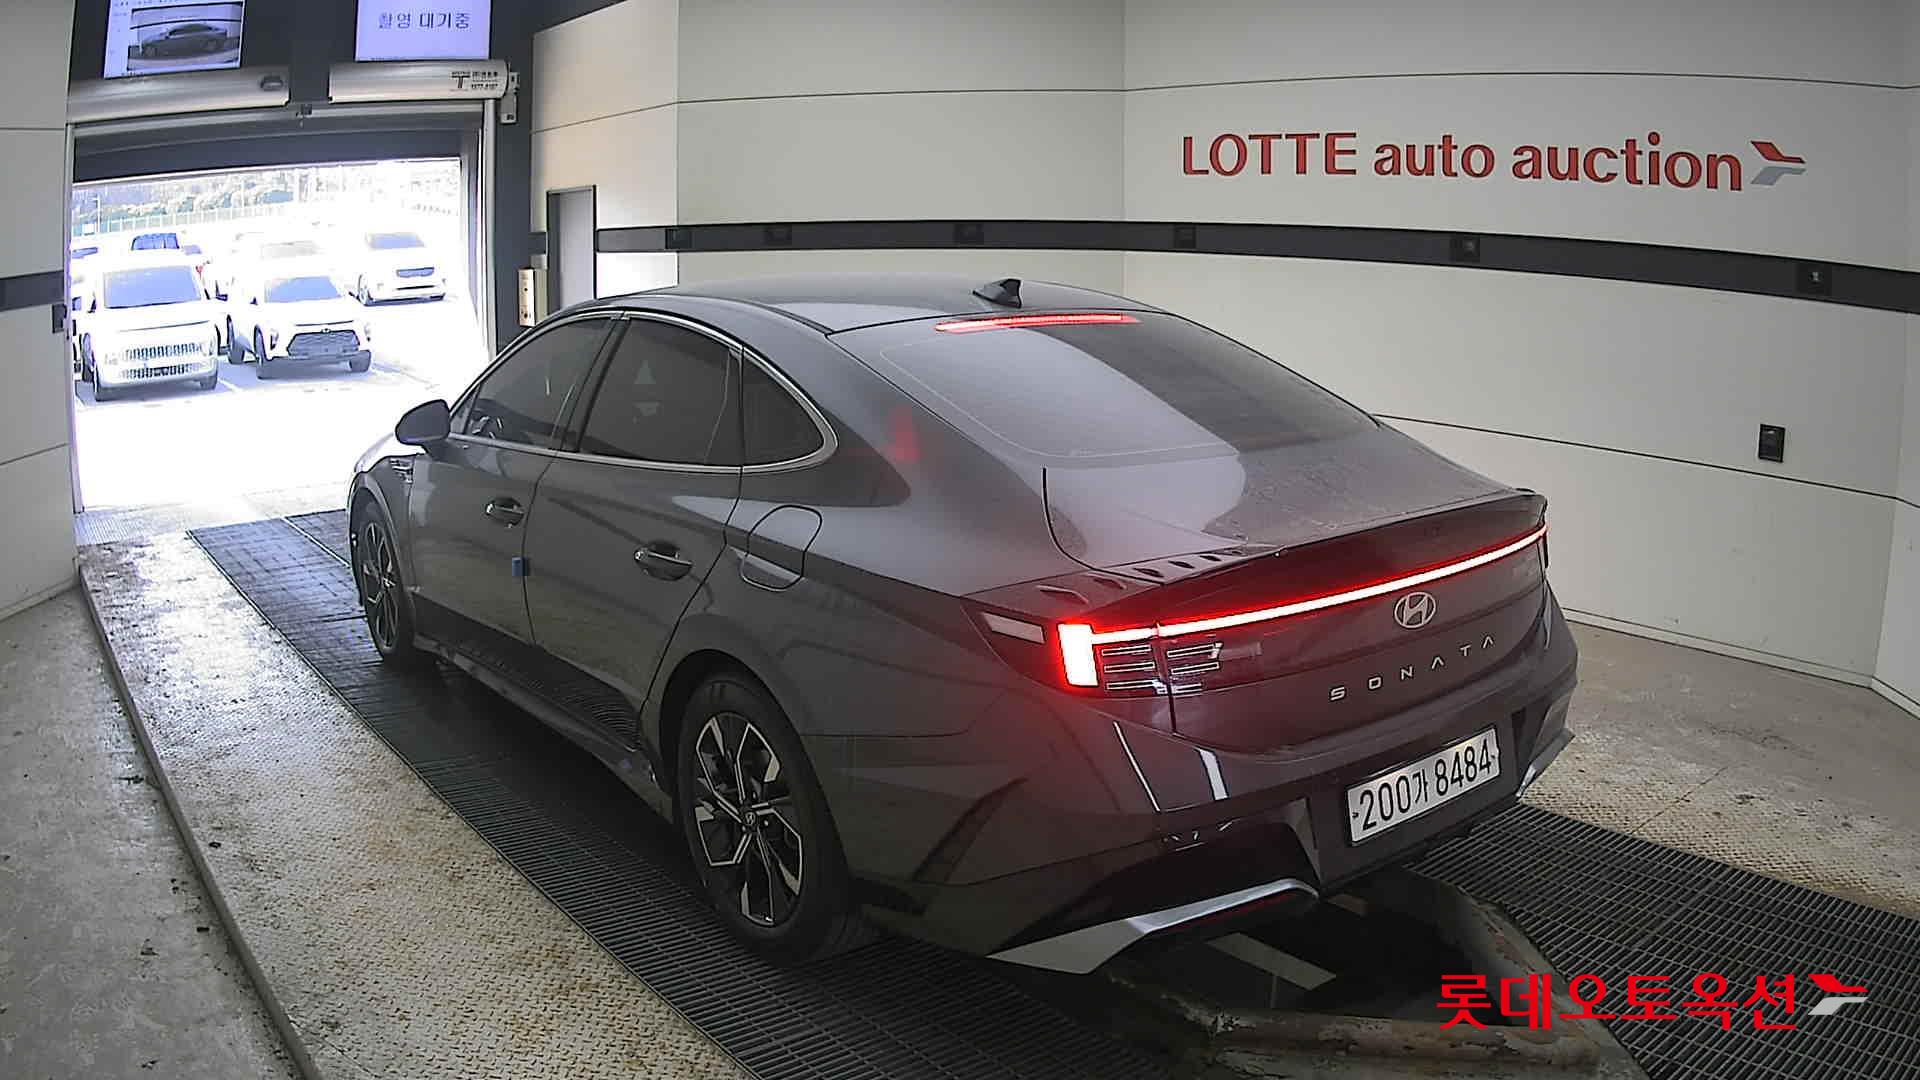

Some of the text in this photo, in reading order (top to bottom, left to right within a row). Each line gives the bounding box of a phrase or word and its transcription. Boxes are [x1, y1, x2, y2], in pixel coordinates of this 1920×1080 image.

[419, 12, 470, 29] 대기중
[1183, 131, 1742, 192] LOTTE auto auction
[1330, 635, 1494, 701] SONATA
[1360, 738, 1492, 831] 200가 8484
